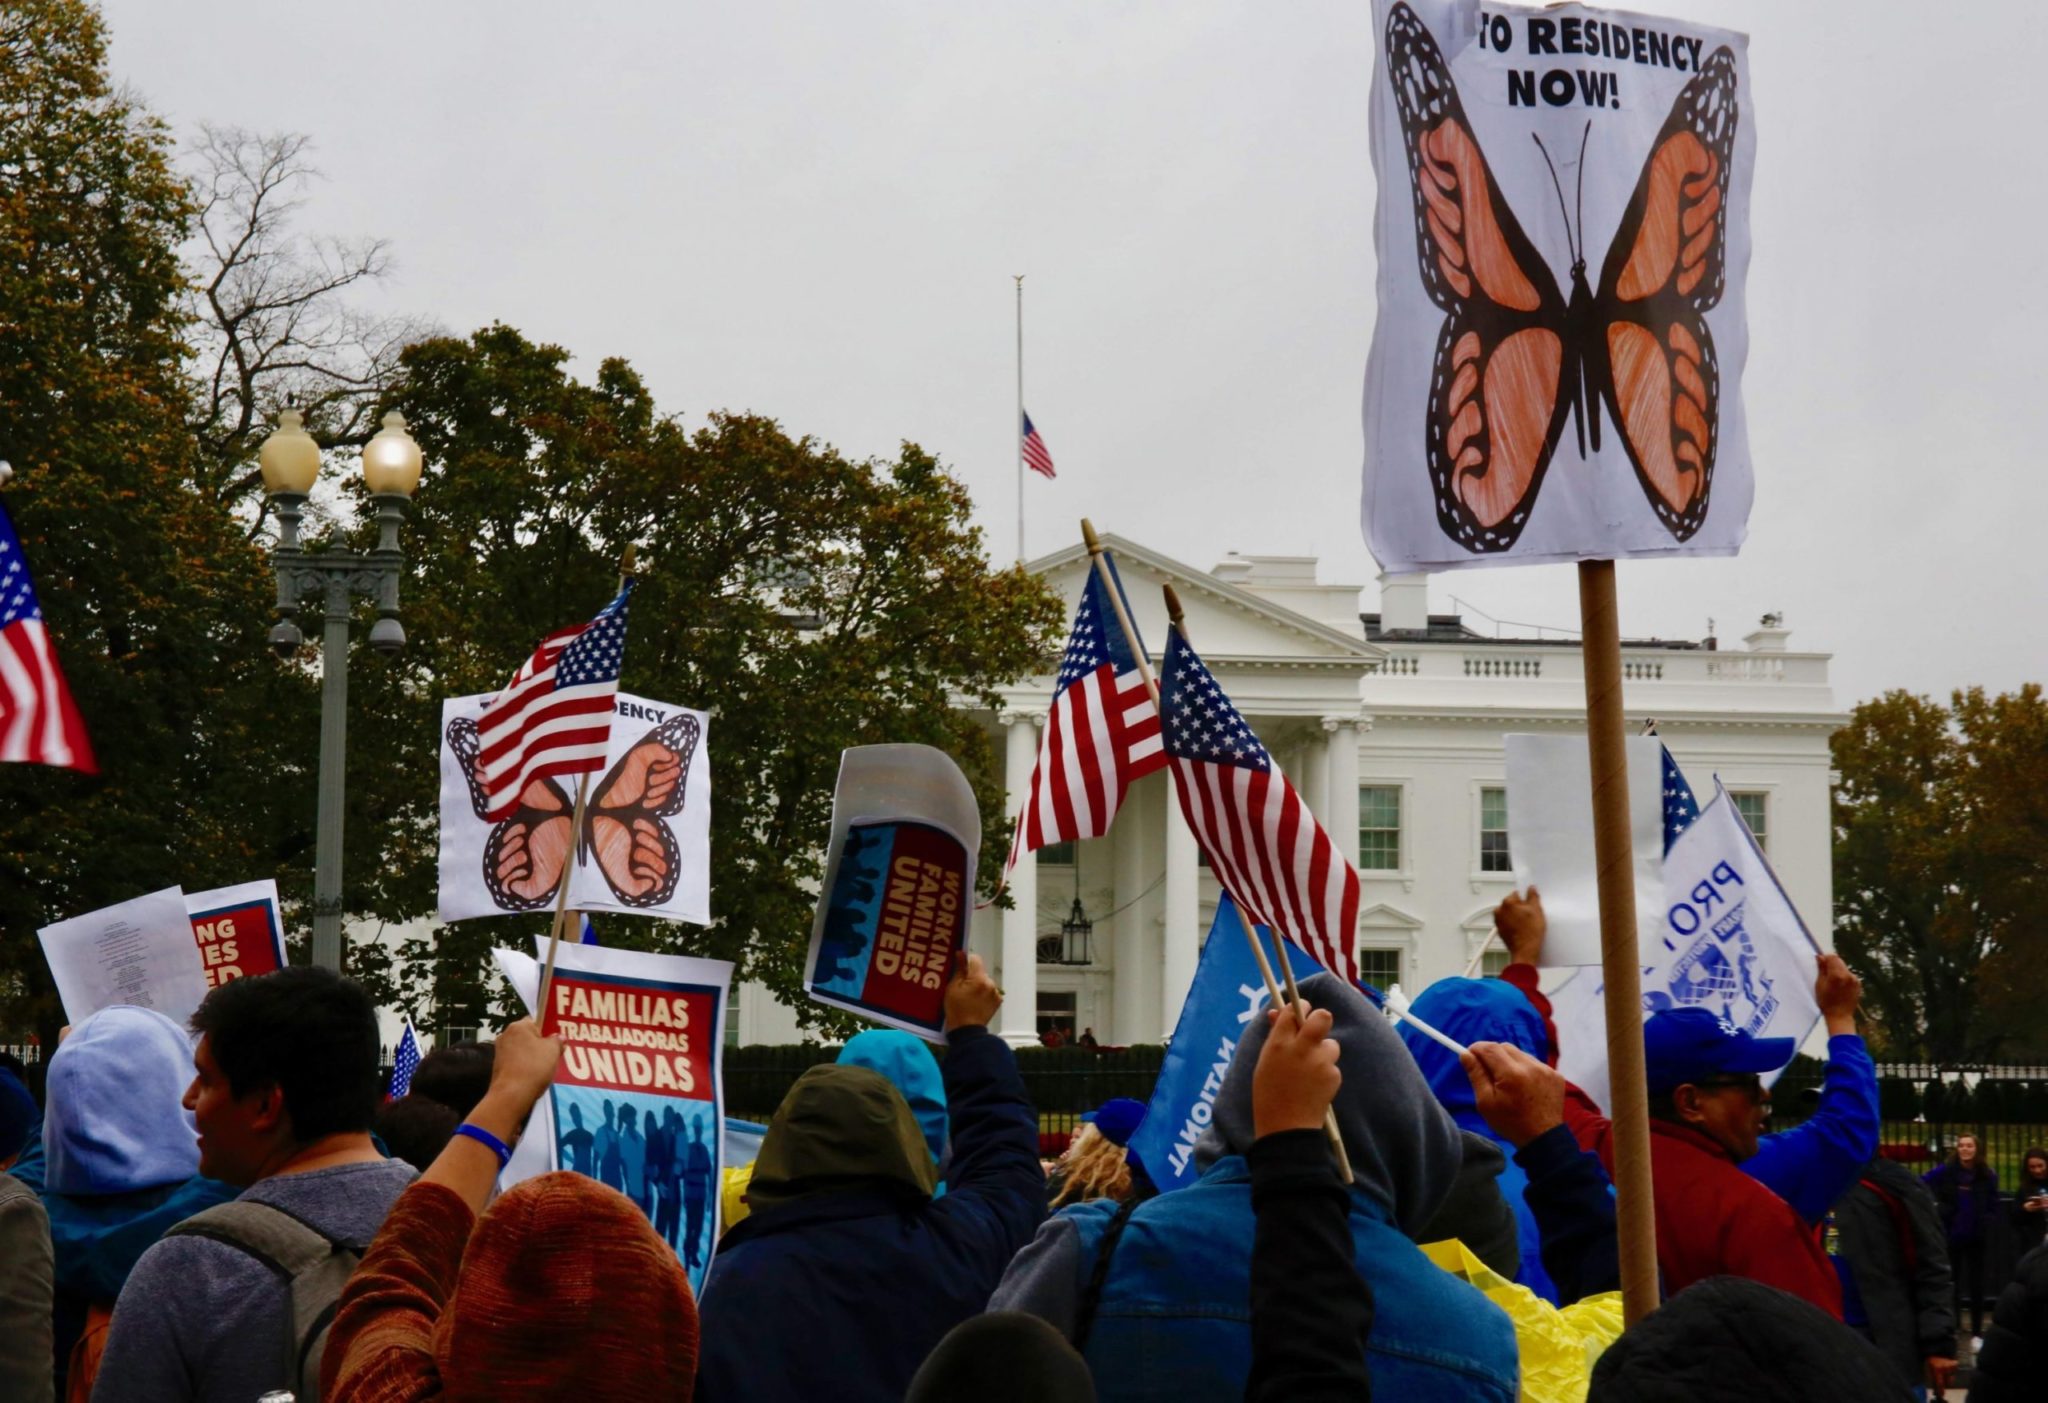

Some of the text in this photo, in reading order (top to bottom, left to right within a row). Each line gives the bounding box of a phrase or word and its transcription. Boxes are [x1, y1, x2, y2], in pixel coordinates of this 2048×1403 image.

[1528, 17, 1703, 72] RESIDENCY
[1508, 69, 1621, 109] NOW!
[613, 701, 666, 724] ENCY
[875, 856, 921, 976] UNITED
[900, 862, 942, 984] FAMILIES
[922, 871, 961, 990] WORKING
[556, 985, 690, 1029] FAMILIAS
[557, 1020, 690, 1053] TRABAJADORAS
[563, 1045, 695, 1092] UNIDAS
